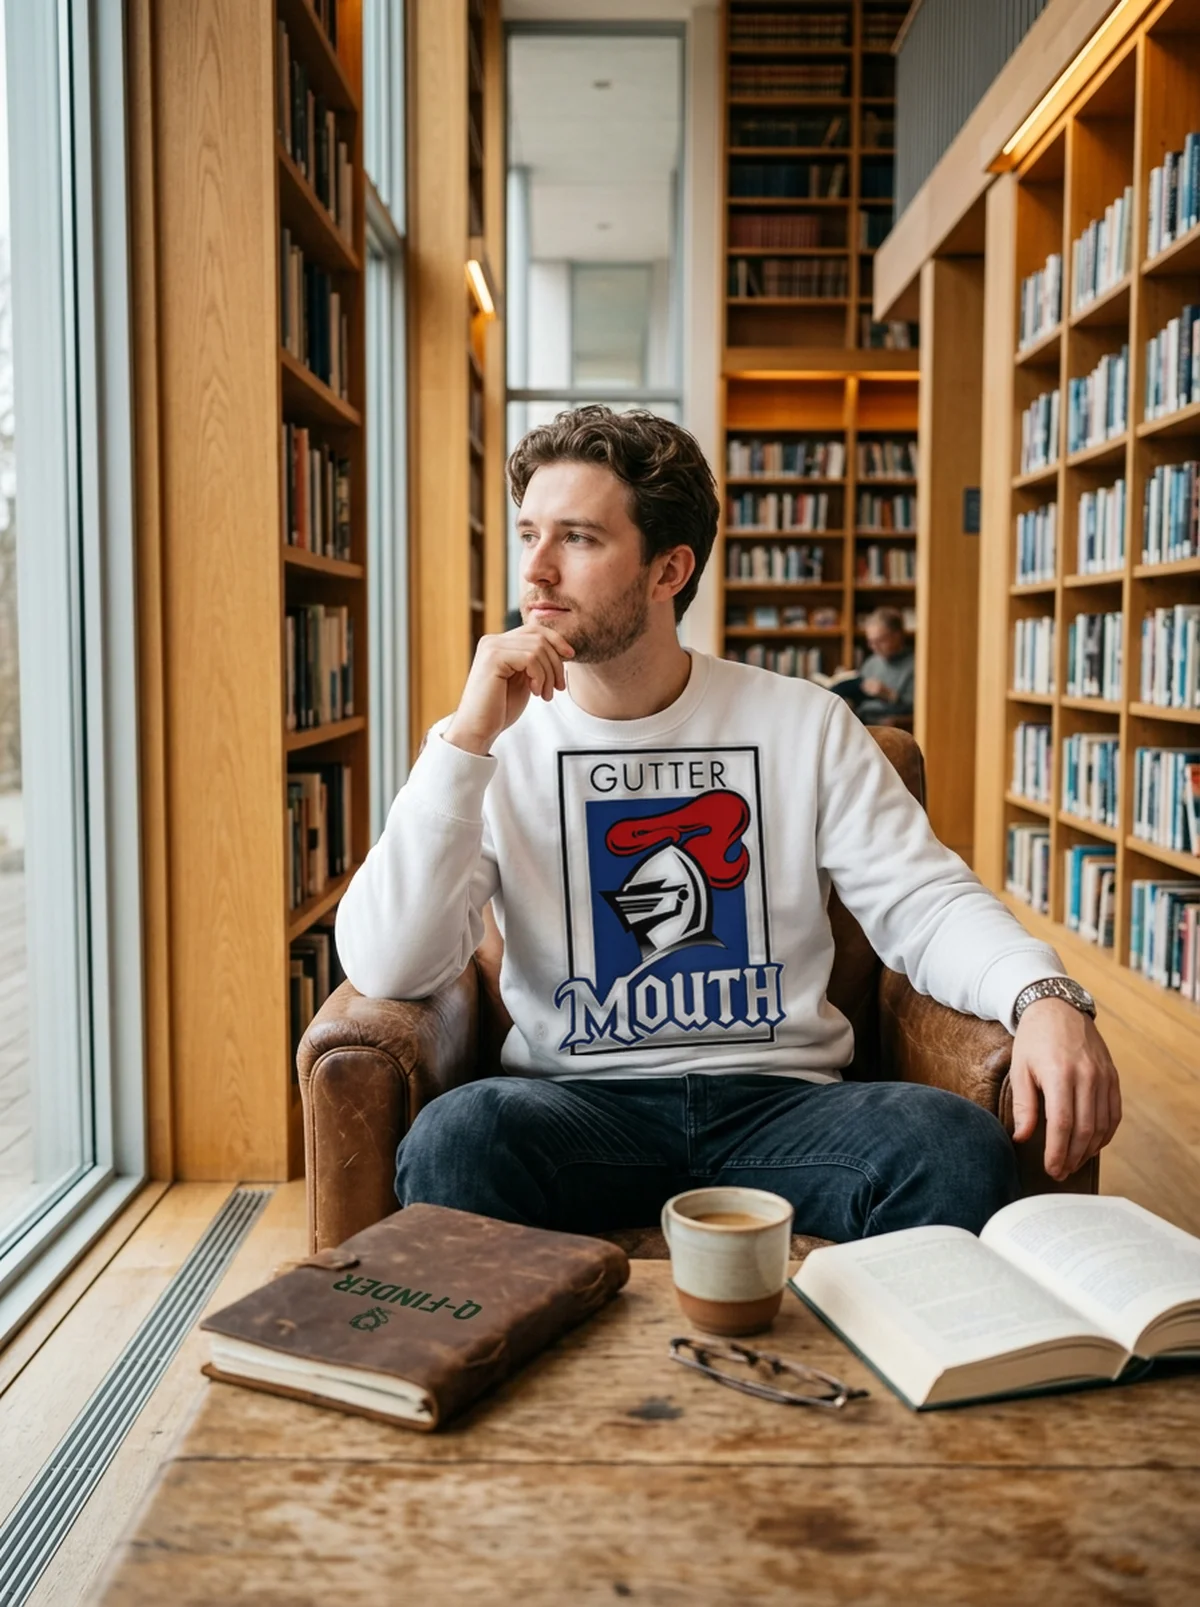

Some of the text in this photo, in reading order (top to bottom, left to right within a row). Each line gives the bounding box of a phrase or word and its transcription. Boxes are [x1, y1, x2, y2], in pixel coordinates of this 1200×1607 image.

[590, 761, 727, 792] GUTTER
[554, 962, 786, 1051] MOUTH
[333, 1274, 482, 1319] Q-FINDER
